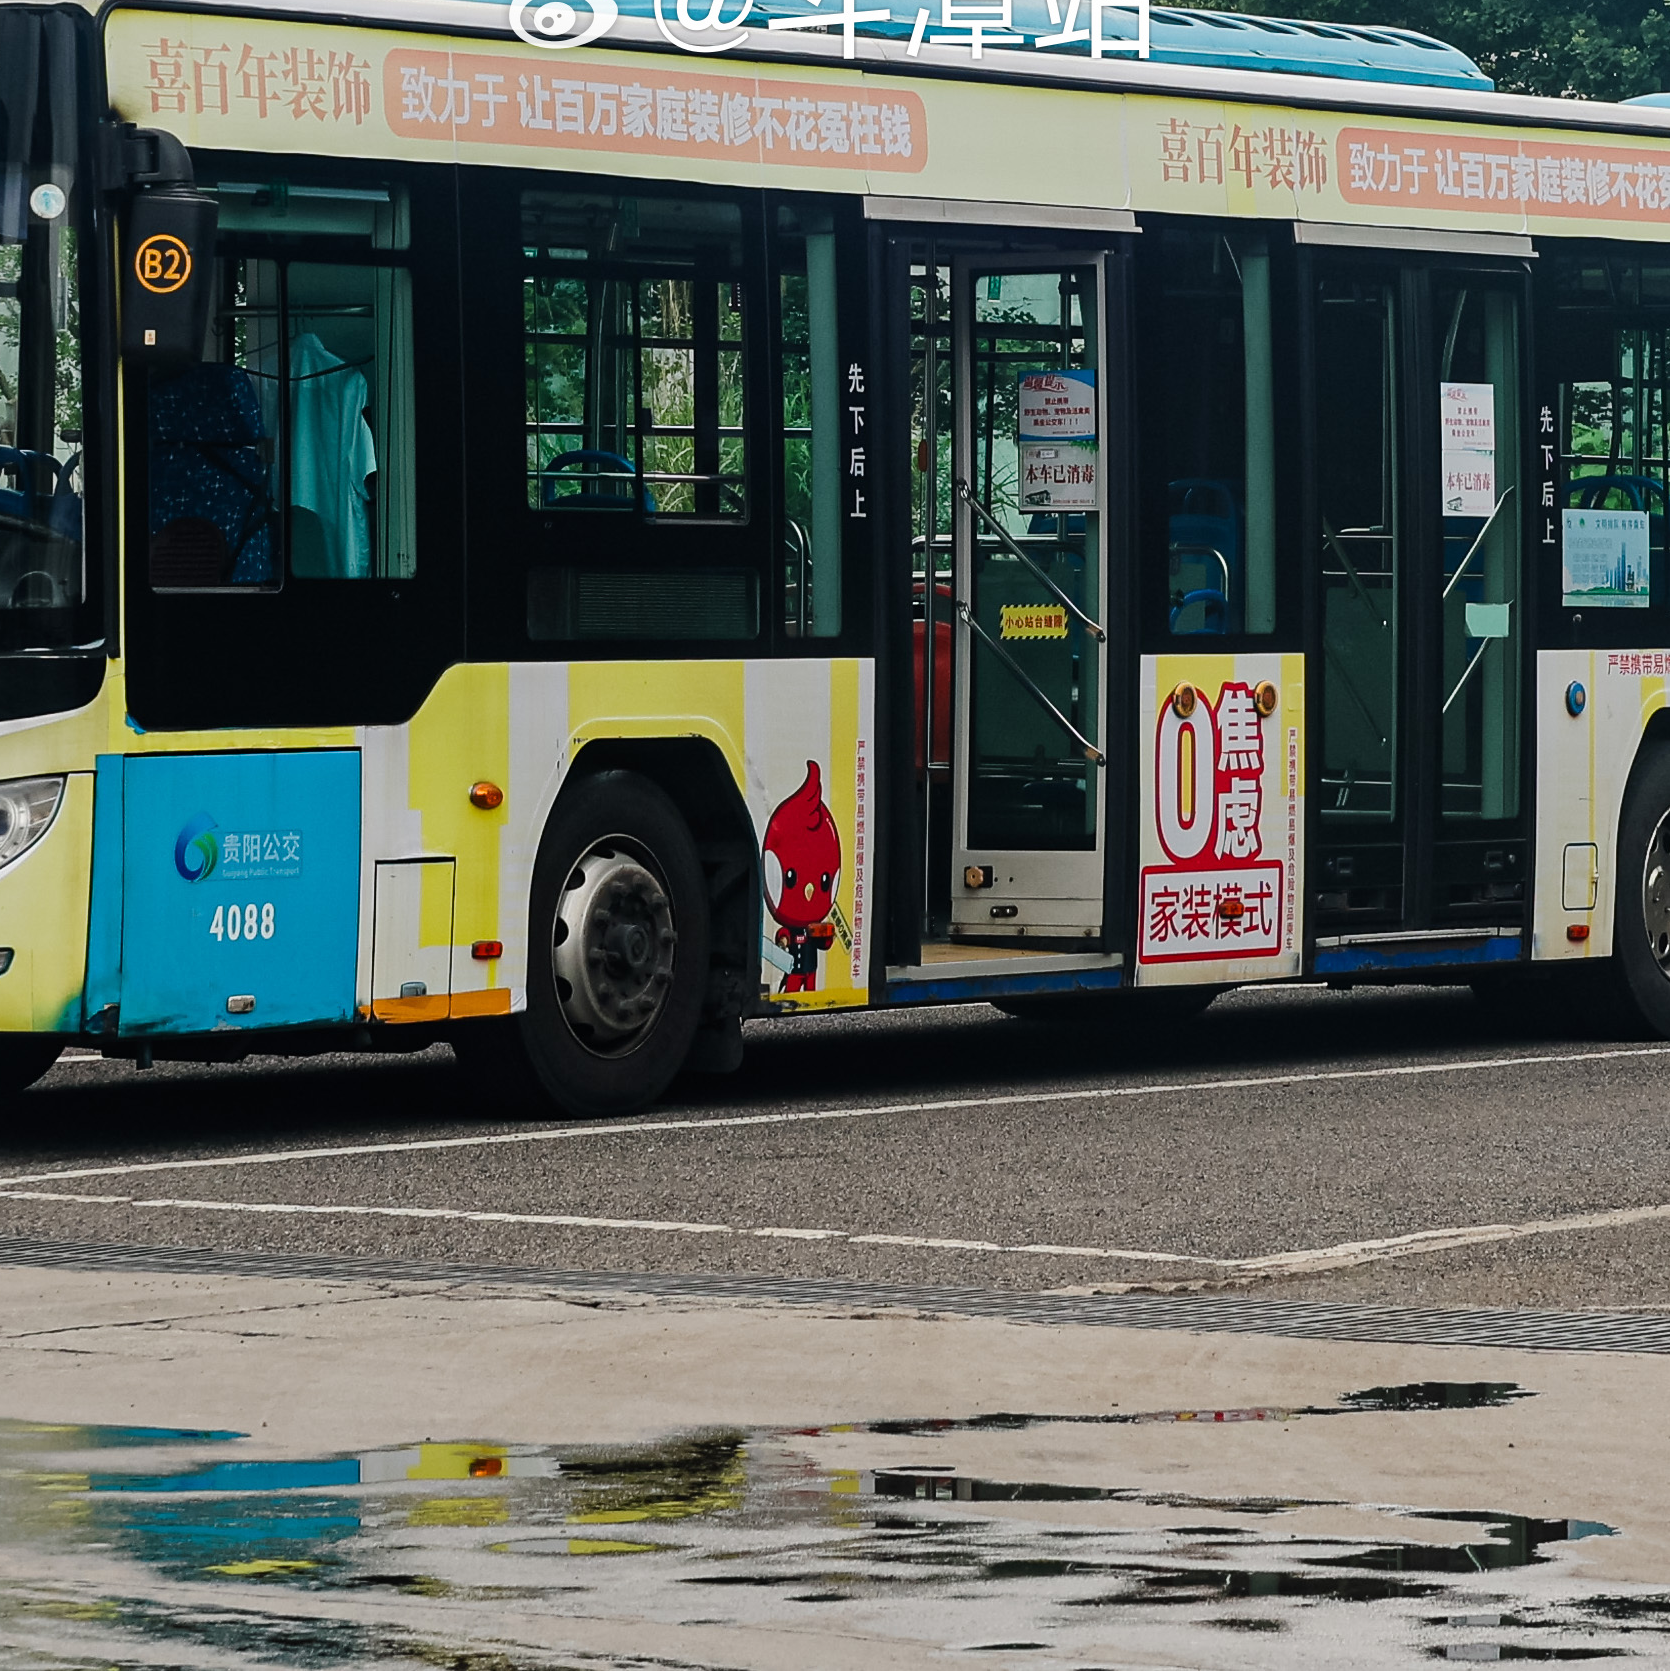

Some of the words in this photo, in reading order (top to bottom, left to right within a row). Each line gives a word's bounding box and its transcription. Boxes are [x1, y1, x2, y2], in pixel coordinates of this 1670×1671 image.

[140, 37, 372, 126] 喜百年装饰
[399, 66, 508, 128] 致力于
[516, 74, 913, 159] 让百万家庭装修不花冤枉钱
[1156, 116, 1328, 195] 喜百年装饰
[1348, 141, 1429, 195] 致力于
[144, 248, 181, 280] B2
[848, 362, 867, 518] 先下后上
[1025, 463, 1095, 485] 本车已消毒
[1446, 472, 1492, 492] 本车已消毒
[1540, 405, 1556, 544] 先下后上
[222, 832, 300, 864] 贵阳公交
[210, 902, 275, 942] 4088
[1149, 880, 1273, 942] 家装模式
